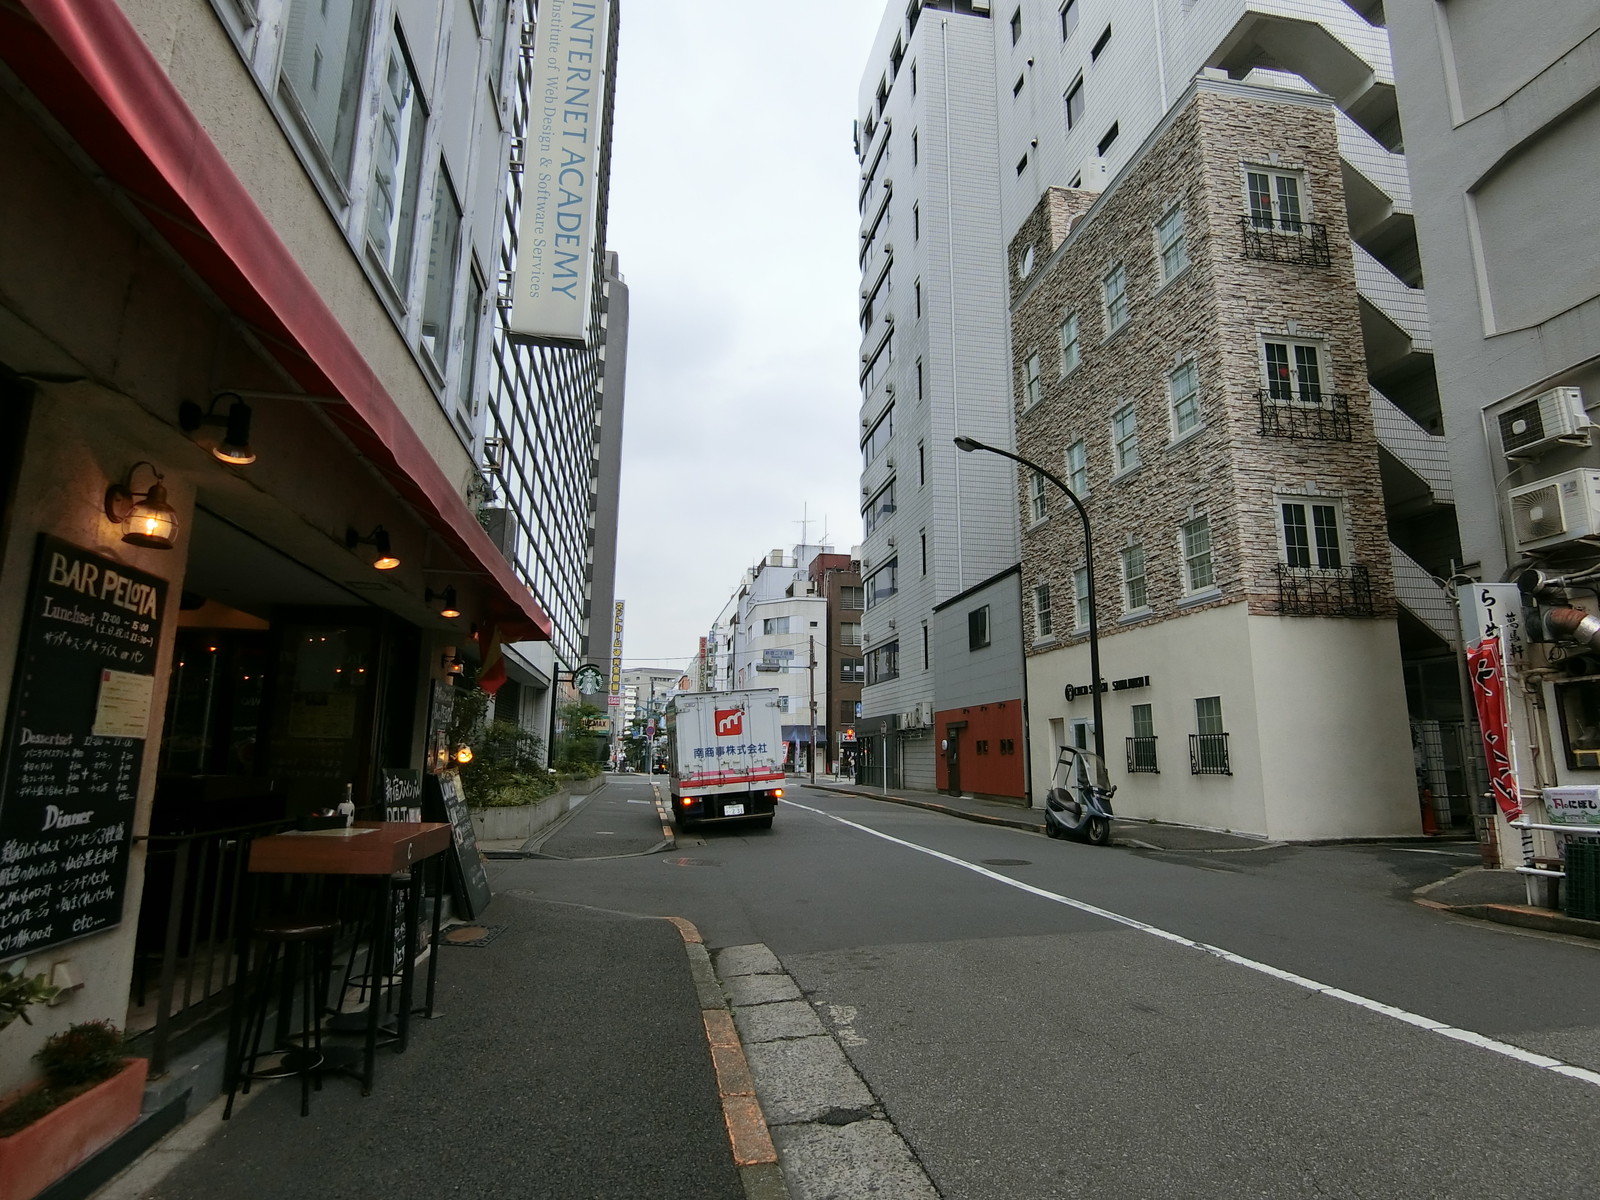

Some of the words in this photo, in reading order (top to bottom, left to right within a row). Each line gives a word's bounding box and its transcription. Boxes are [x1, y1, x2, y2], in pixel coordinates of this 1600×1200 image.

[544, 77, 559, 103] Web
[548, 57, 560, 71] of
[562, 2, 596, 144] INTERNET
[537, 106, 557, 153] Design
[534, 173, 551, 236] Software
[551, 146, 585, 301] ACADEMY
[529, 238, 546, 299] Services
[48, 551, 99, 598] BAR
[100, 569, 157, 620] PELOTA
[693, 742, 768, 759] 南商事株式会社
[41, 804, 95, 832] Dinner
